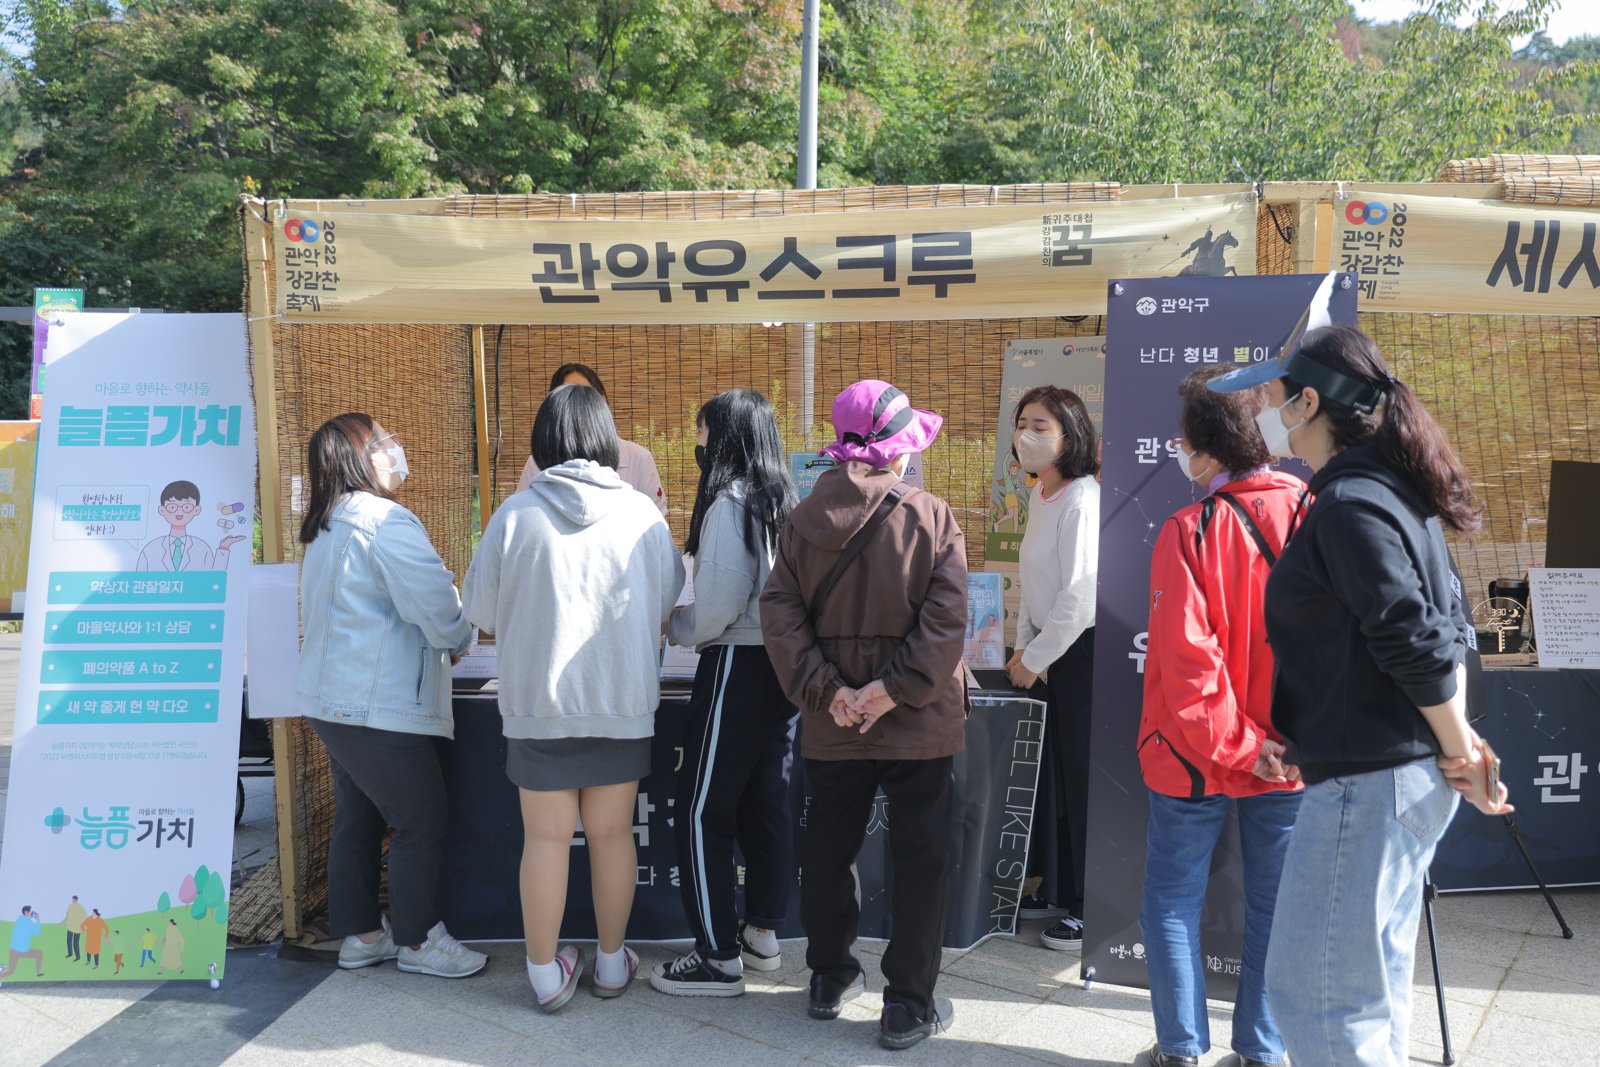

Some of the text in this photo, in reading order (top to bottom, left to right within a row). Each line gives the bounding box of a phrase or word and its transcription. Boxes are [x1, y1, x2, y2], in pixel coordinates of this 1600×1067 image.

[1389, 203, 1407, 248] 2022
[323, 220, 337, 265] 2022
[1052, 224, 1092, 267] 꿈
[1342, 230, 1385, 251] 관악
[285, 247, 320, 267] 관악
[532, 231, 976, 304] 관악유스크루
[1340, 254, 1404, 275] 강감찬
[286, 270, 340, 291] 강감찬
[286, 293, 320, 312] 축제
[1161, 298, 1209, 314] 관악구
[1140, 348, 1174, 363] 난다
[1184, 347, 1218, 363] 청년
[1234, 347, 1269, 363] 별이
[95, 382, 212, 396] 마을로 향하는 약사들
[57, 405, 242, 446] 늘픔가치
[90, 580, 184, 594] 약상자 관찰일지
[77, 621, 192, 635] 마을약사와 1:1 상담
[83, 661, 179, 675] 폐의약품 A to Z
[66, 700, 189, 714] 새 약 줄게 헌 약 다오
[1010, 701, 1045, 777] FEEL
[138, 808, 157, 816] 마을로
[158, 808, 176, 816] 향하는
[1000, 786, 1035, 853] LIKE
[137, 817, 194, 849] 가치
